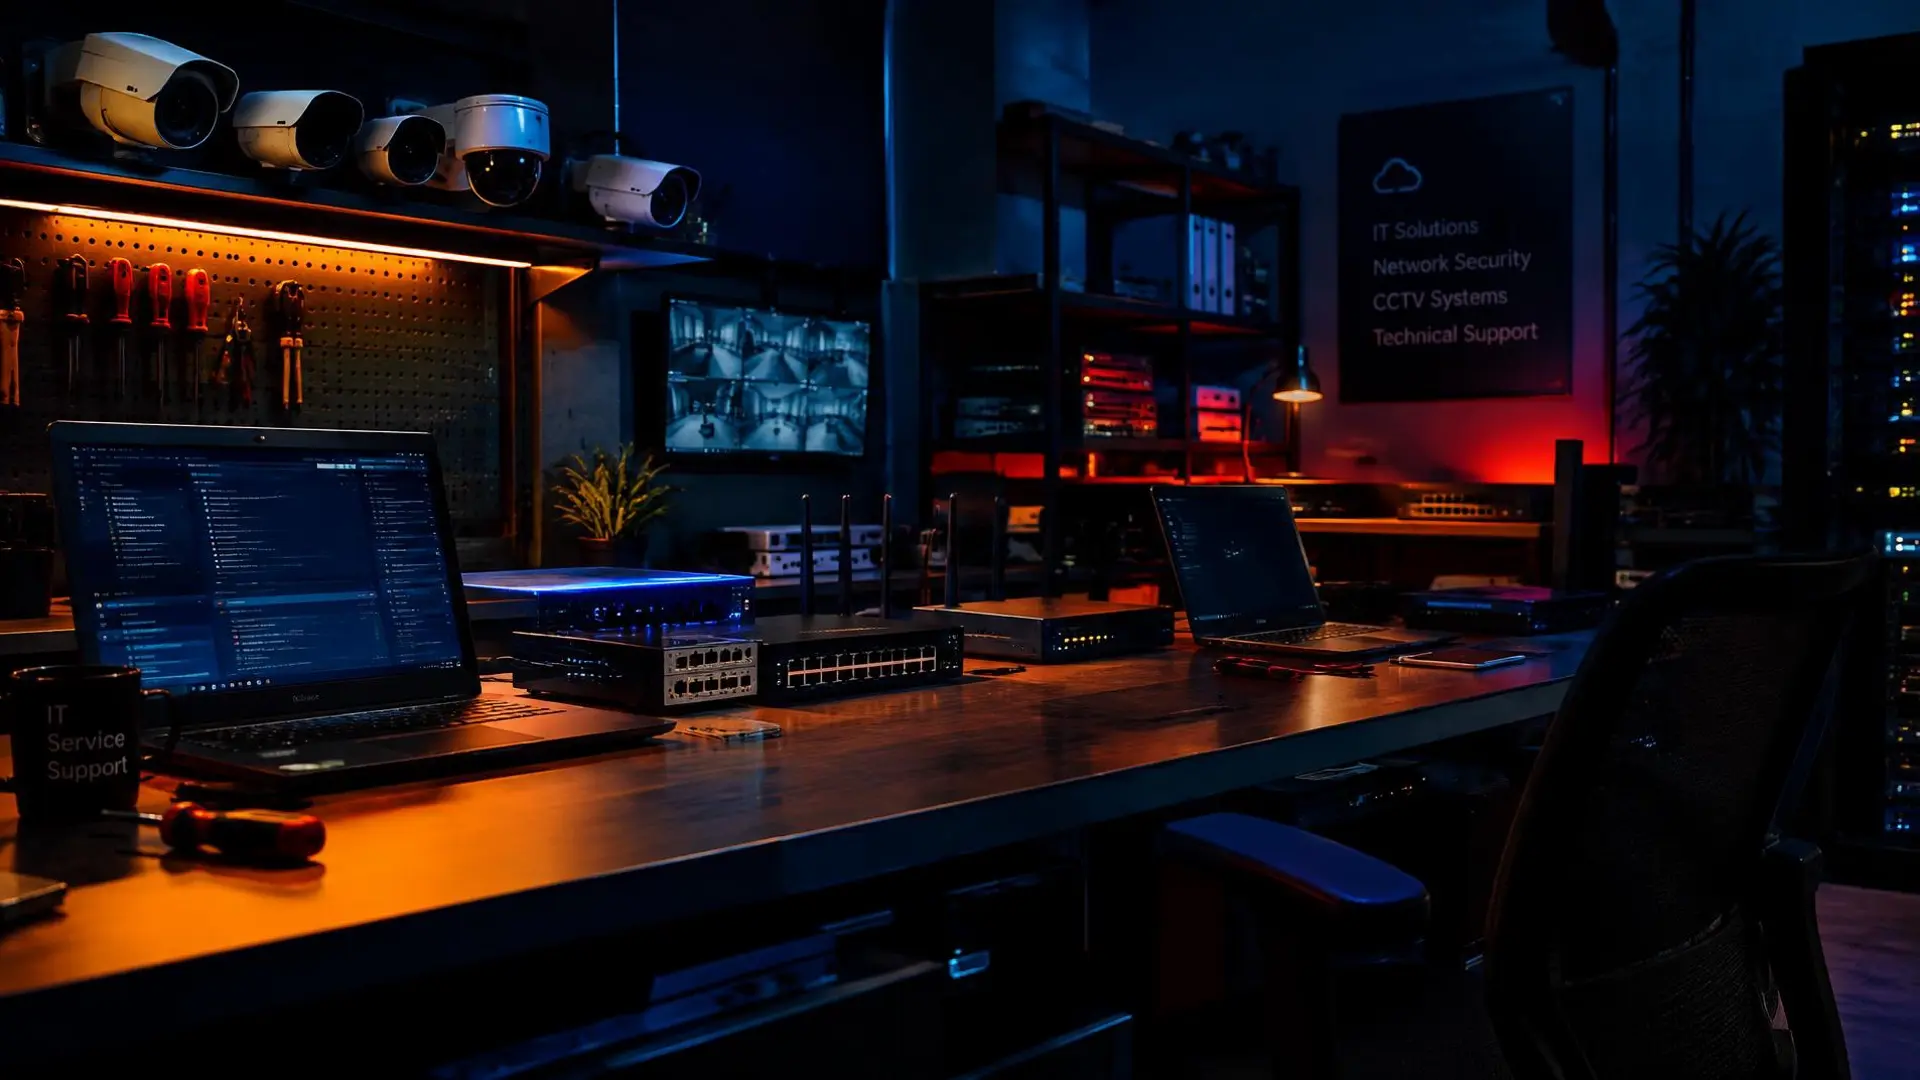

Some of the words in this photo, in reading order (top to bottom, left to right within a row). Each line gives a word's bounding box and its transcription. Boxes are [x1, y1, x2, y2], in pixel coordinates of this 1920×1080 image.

[1373, 224, 1390, 242] IT
[1395, 218, 1480, 240] Solutions
[1373, 253, 1449, 276] Network
[1455, 249, 1532, 272] Security
[1373, 292, 1425, 312] CCTV
[1431, 289, 1508, 312] Systems
[1373, 325, 1457, 347] Technical
[1464, 322, 1539, 345] Support
[47, 705, 69, 725] IT
[47, 730, 125, 752] Service
[47, 756, 128, 784] Support
